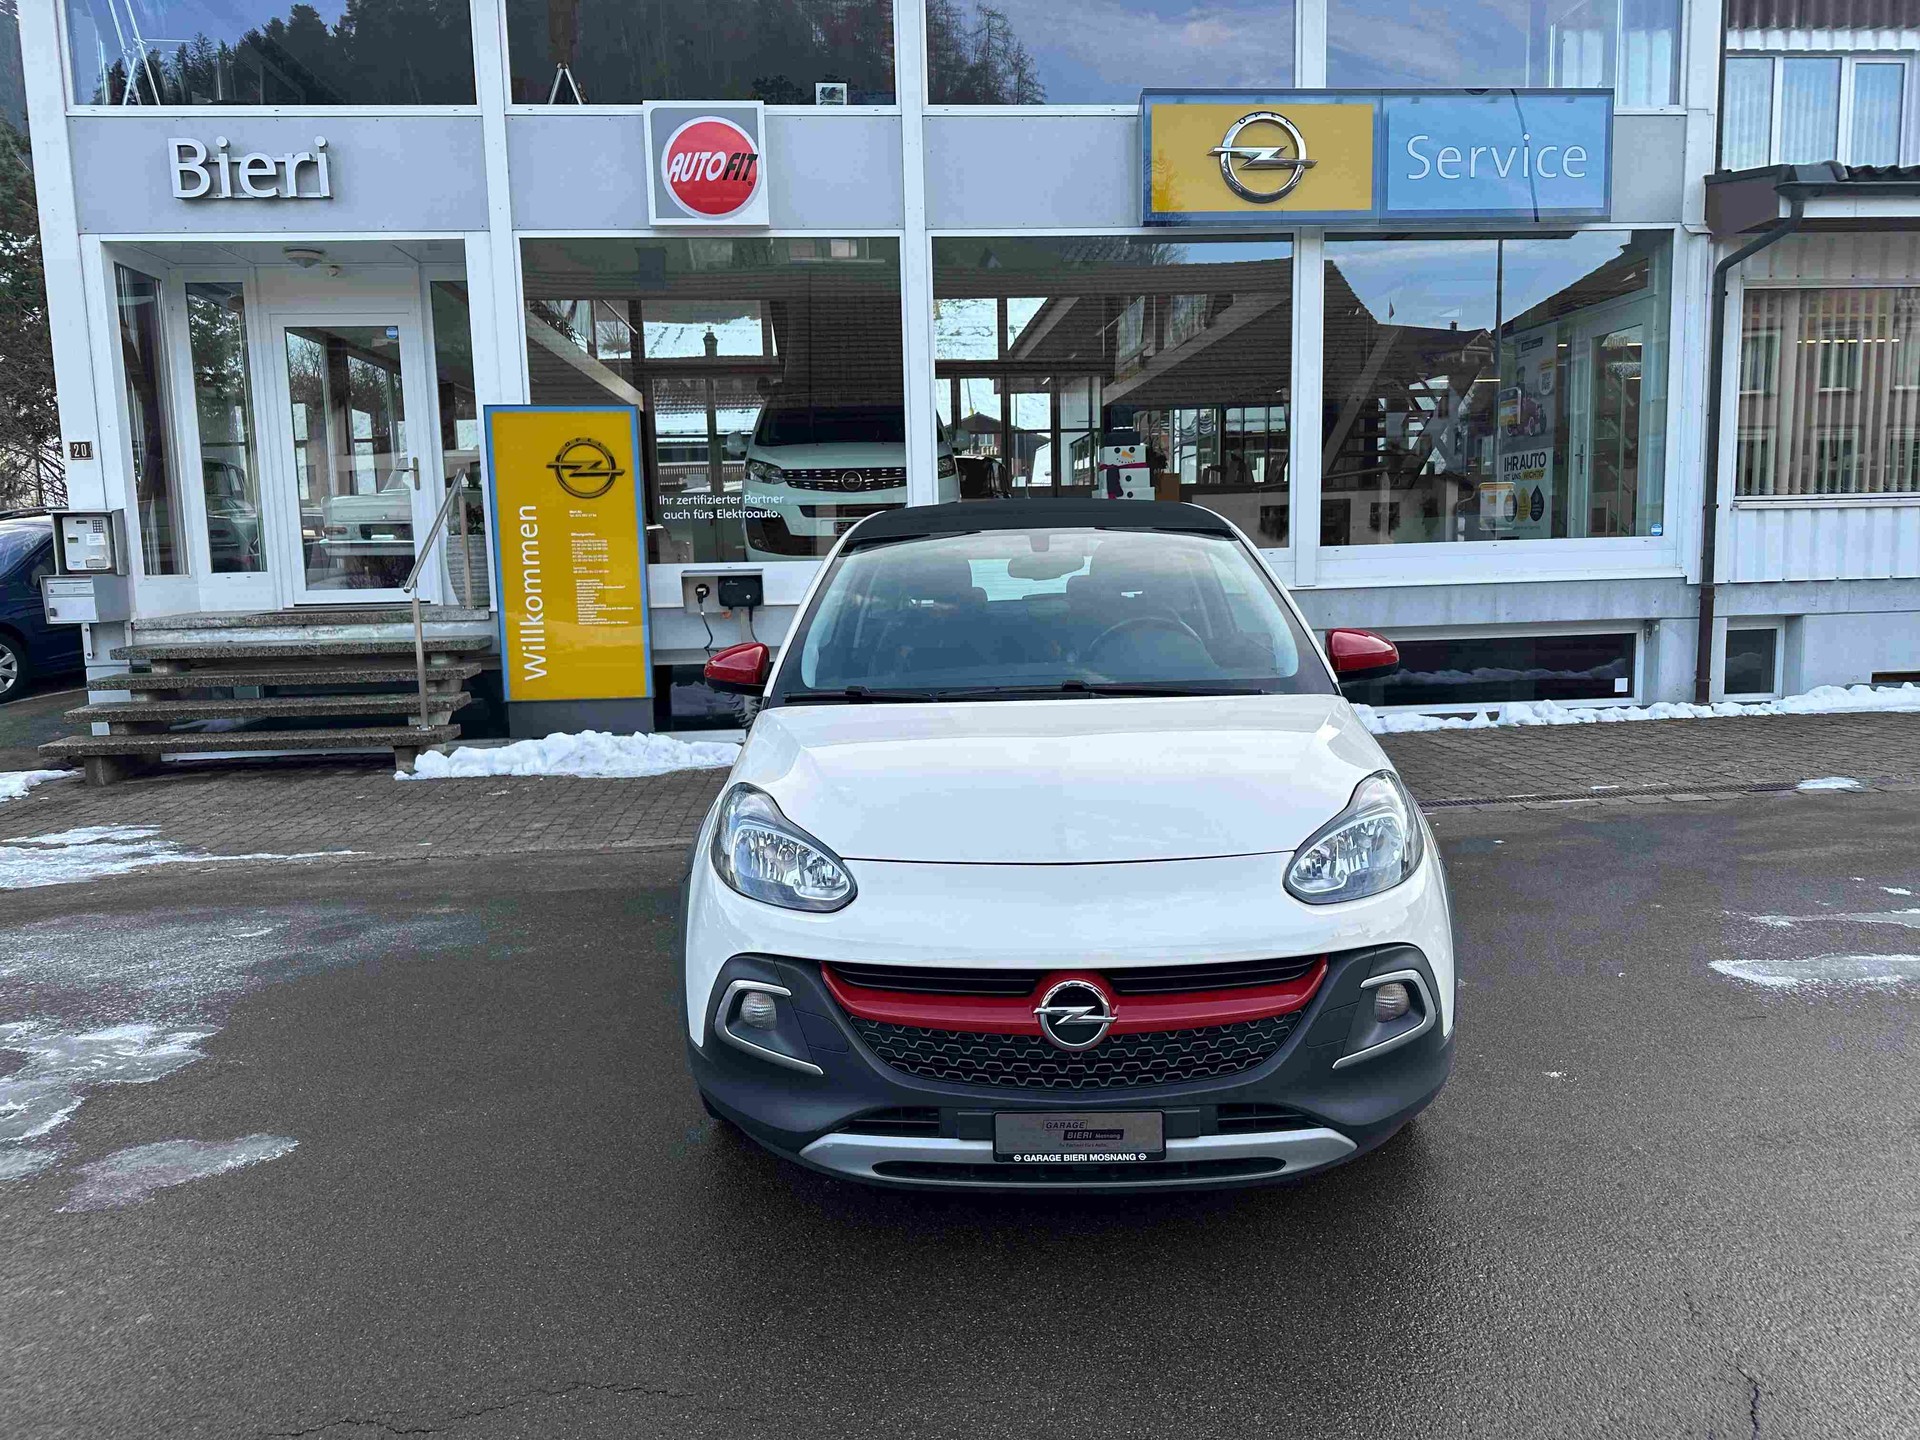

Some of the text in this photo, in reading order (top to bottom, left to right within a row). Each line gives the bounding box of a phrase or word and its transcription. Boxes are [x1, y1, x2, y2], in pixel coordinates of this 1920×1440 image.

[1406, 134, 1588, 180] Service
[168, 135, 331, 198] Bieri
[73, 443, 87, 458] 20
[1504, 451, 1547, 472] IHR AUTO
[659, 494, 784, 505] Ihr zertifizierter Partner
[663, 509, 781, 520] auch fürs Elektroauto.
[519, 505, 547, 681] Willkommen
[1045, 1121, 1085, 1129] GARAGE
[1067, 1131, 1092, 1139] BIERI
[1023, 1153, 1136, 1162] GARAGE BIERI MOSNANG
